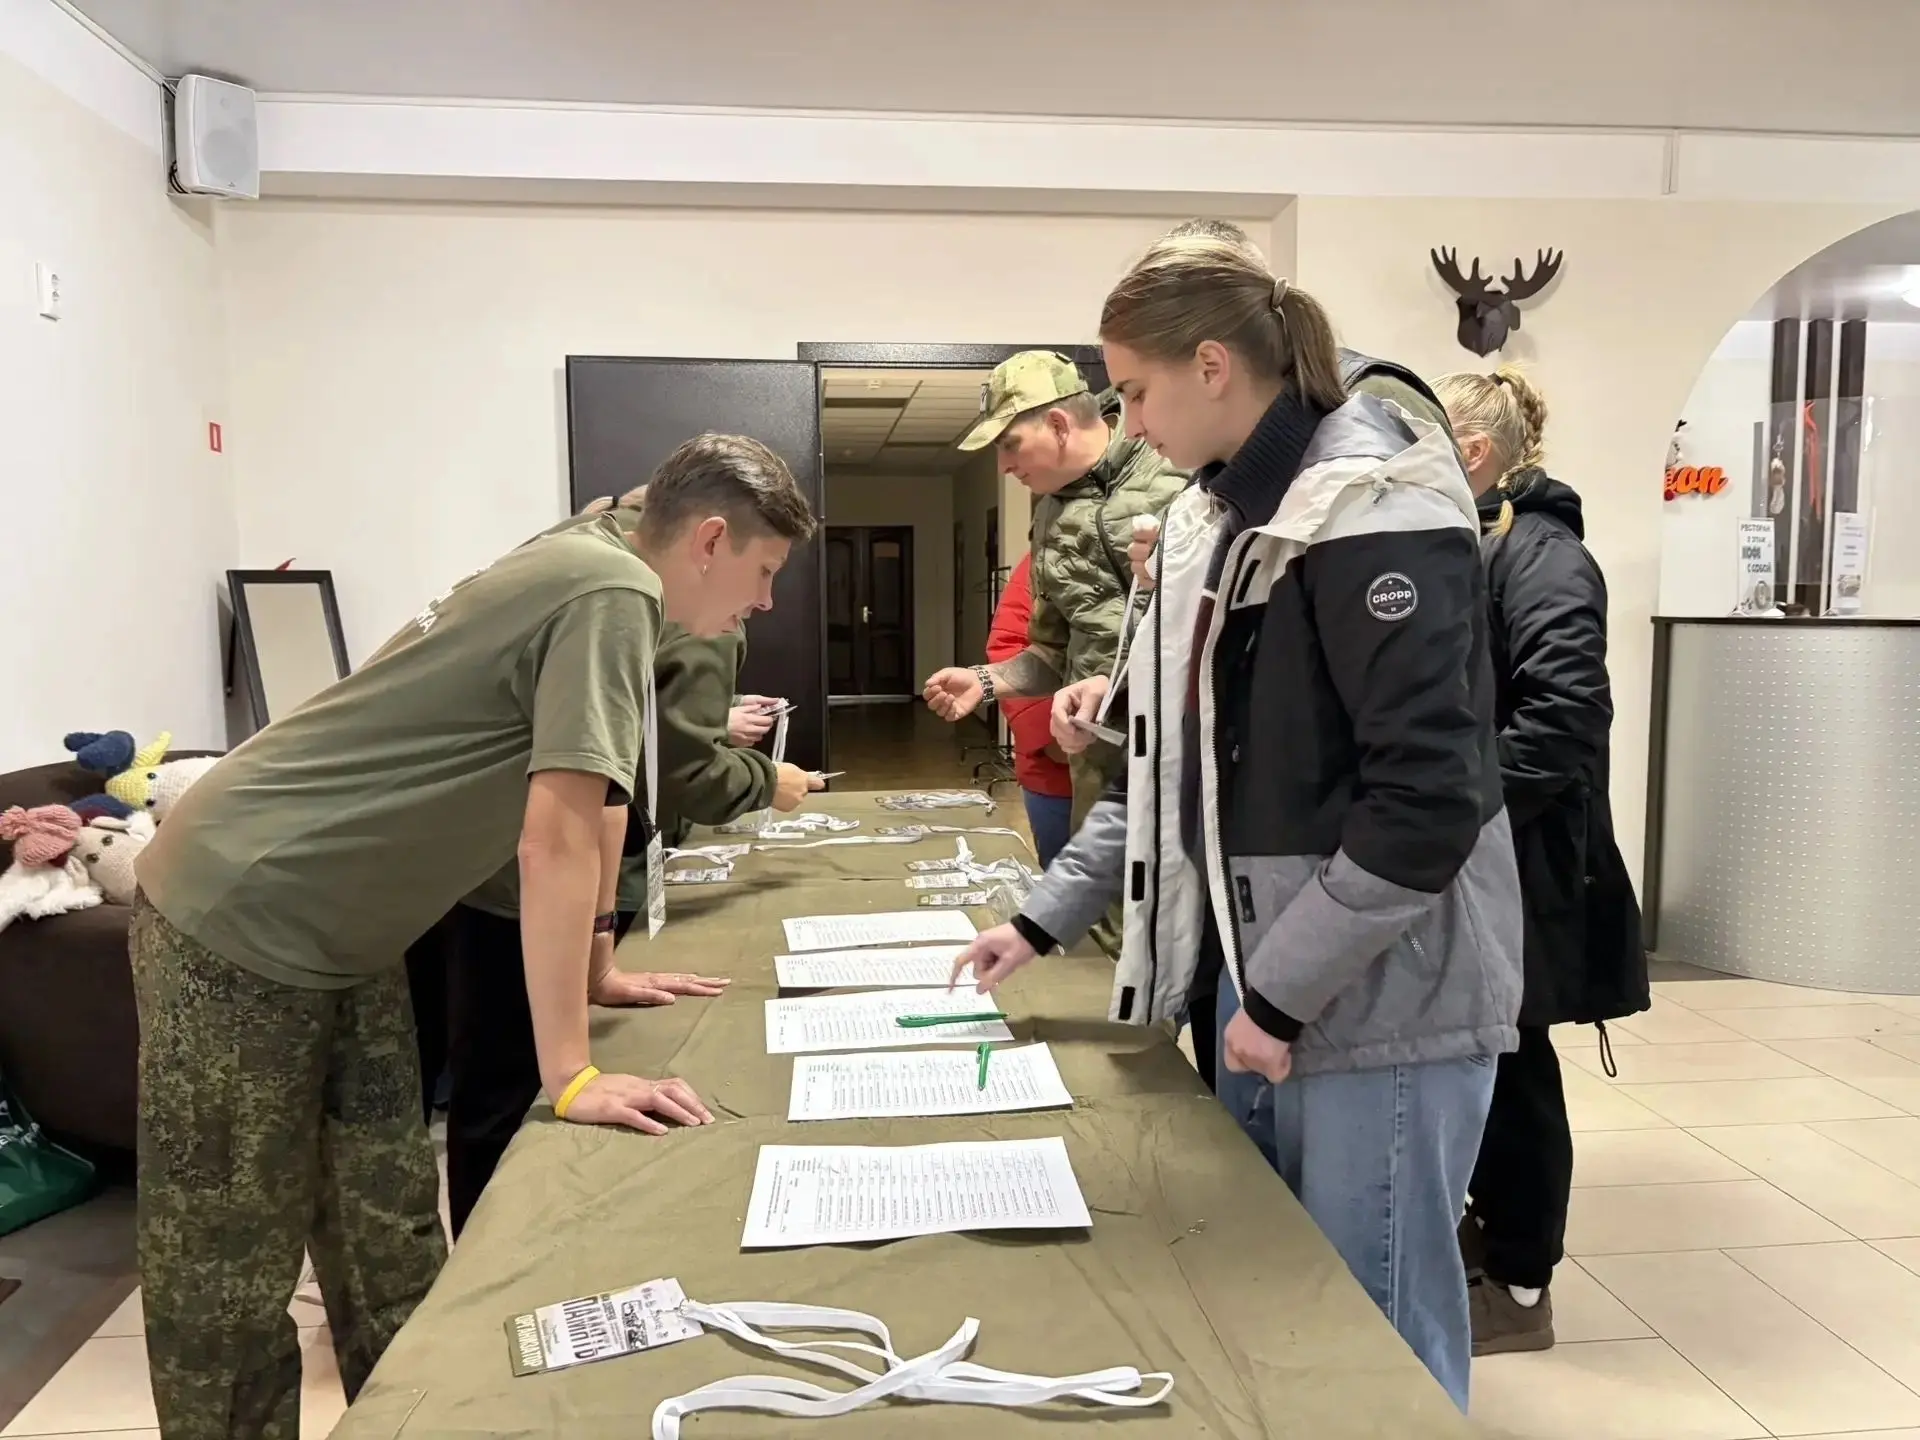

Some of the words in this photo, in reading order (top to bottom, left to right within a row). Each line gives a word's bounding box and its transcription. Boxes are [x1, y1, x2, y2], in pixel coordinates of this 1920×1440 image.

[1664, 466, 1728, 495] on
[1372, 590, 1412, 604] CROPP
[514, 1314, 543, 1367] ОРГАНИЗАТОР
